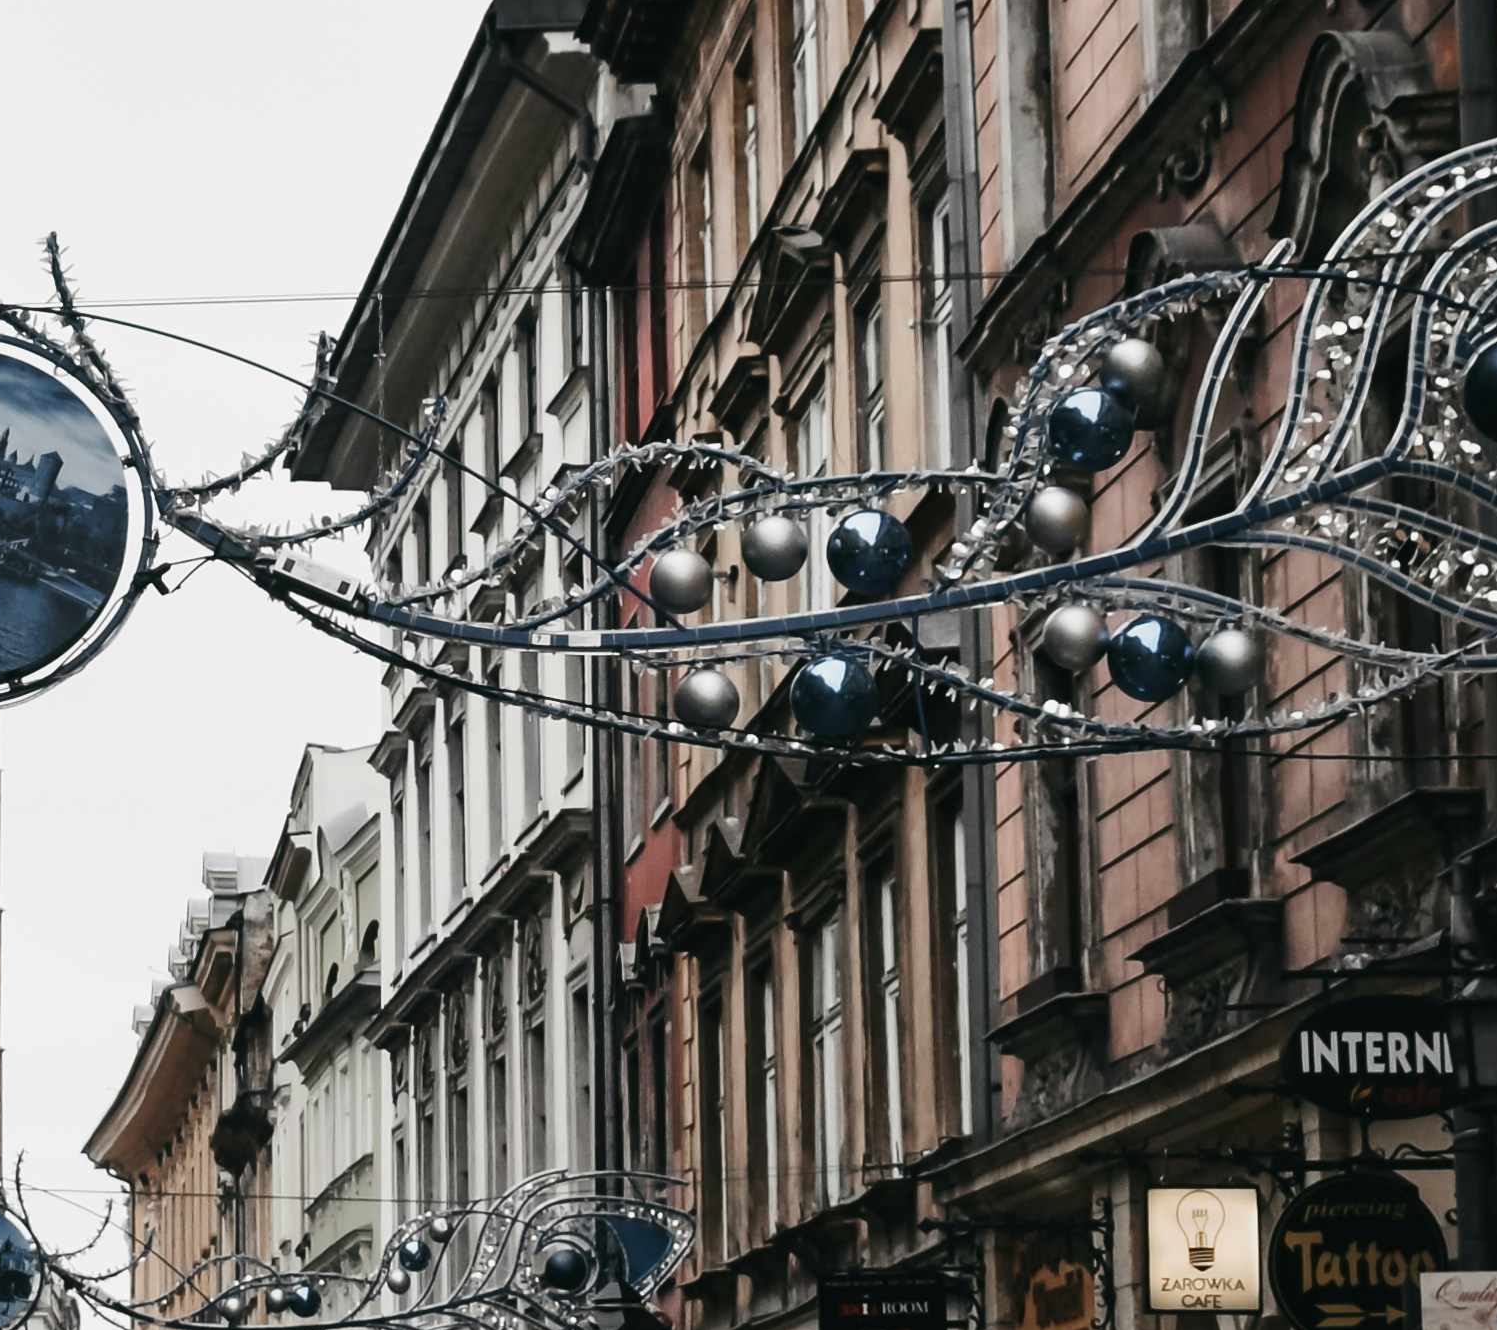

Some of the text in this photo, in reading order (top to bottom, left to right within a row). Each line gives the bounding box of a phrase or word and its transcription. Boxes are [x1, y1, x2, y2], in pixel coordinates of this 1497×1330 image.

[1301, 1030, 1453, 1074] INTERN
[1304, 1199, 1408, 1221] piercing
[1285, 1230, 1437, 1293] Tattoo
[882, 1301, 929, 1315] ROOM
